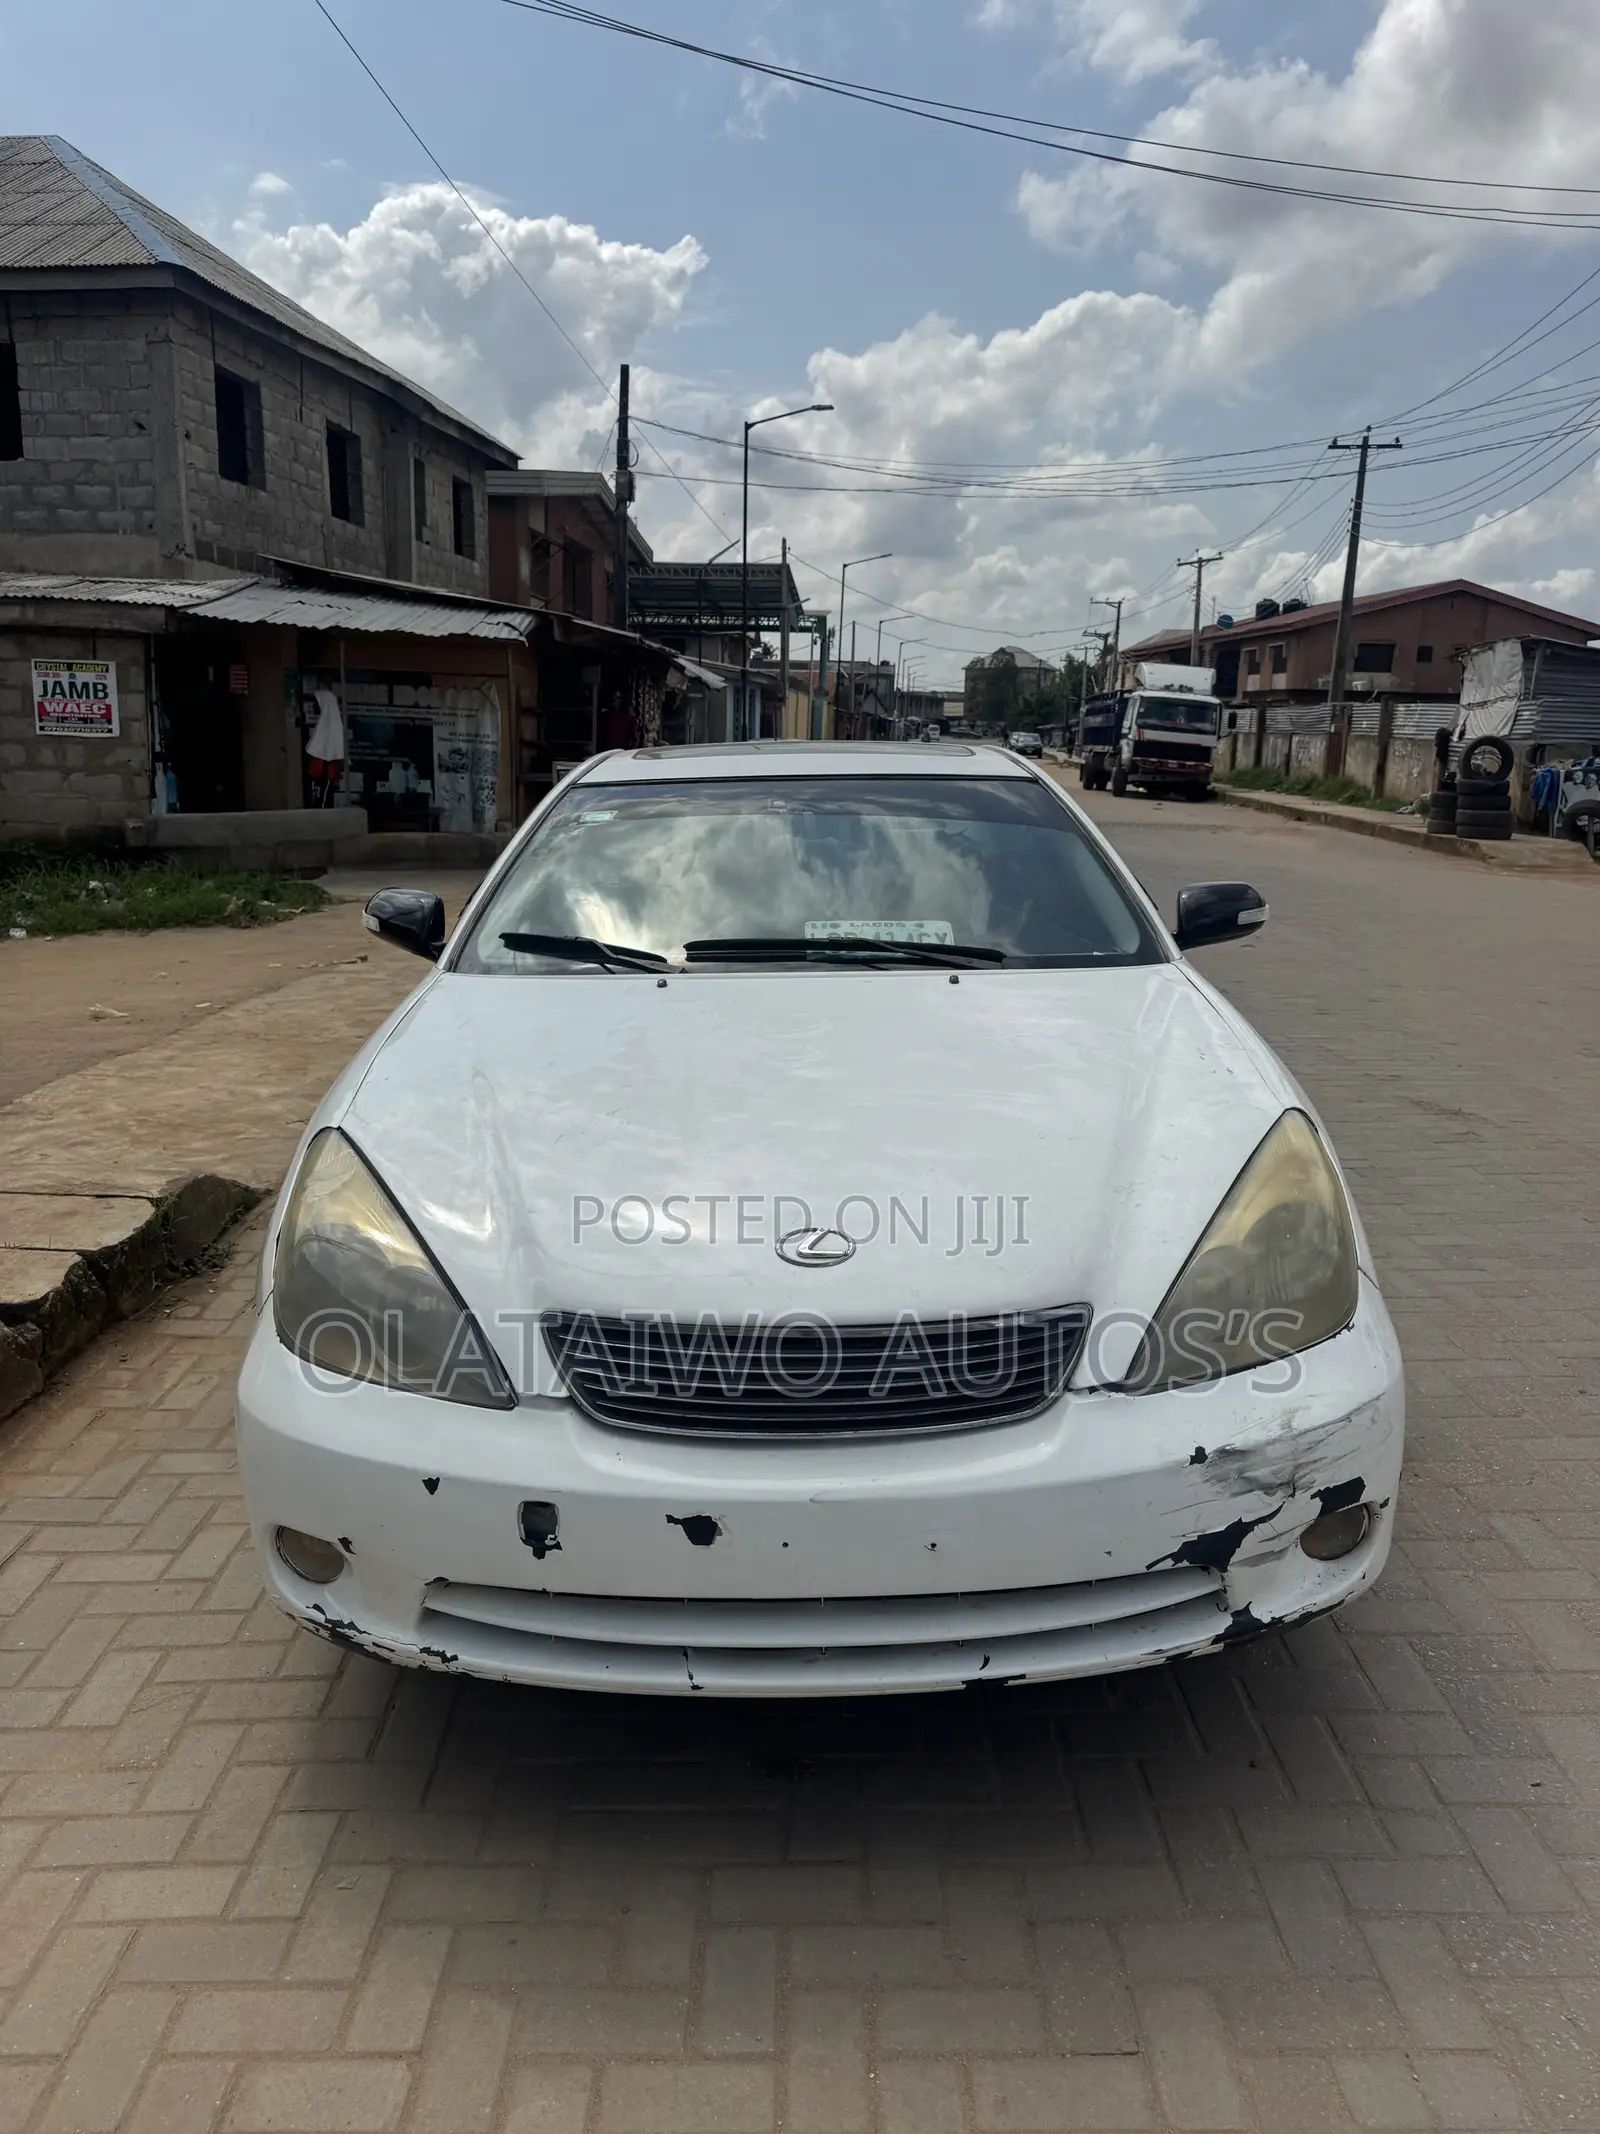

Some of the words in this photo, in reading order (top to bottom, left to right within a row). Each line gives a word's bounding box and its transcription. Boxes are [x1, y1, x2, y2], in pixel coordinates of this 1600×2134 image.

[36, 662, 68, 671] CRYSTAL
[72, 664, 107, 673] ACADEMY
[38, 680, 109, 700] JAMB
[43, 702, 107, 714] WAEC
